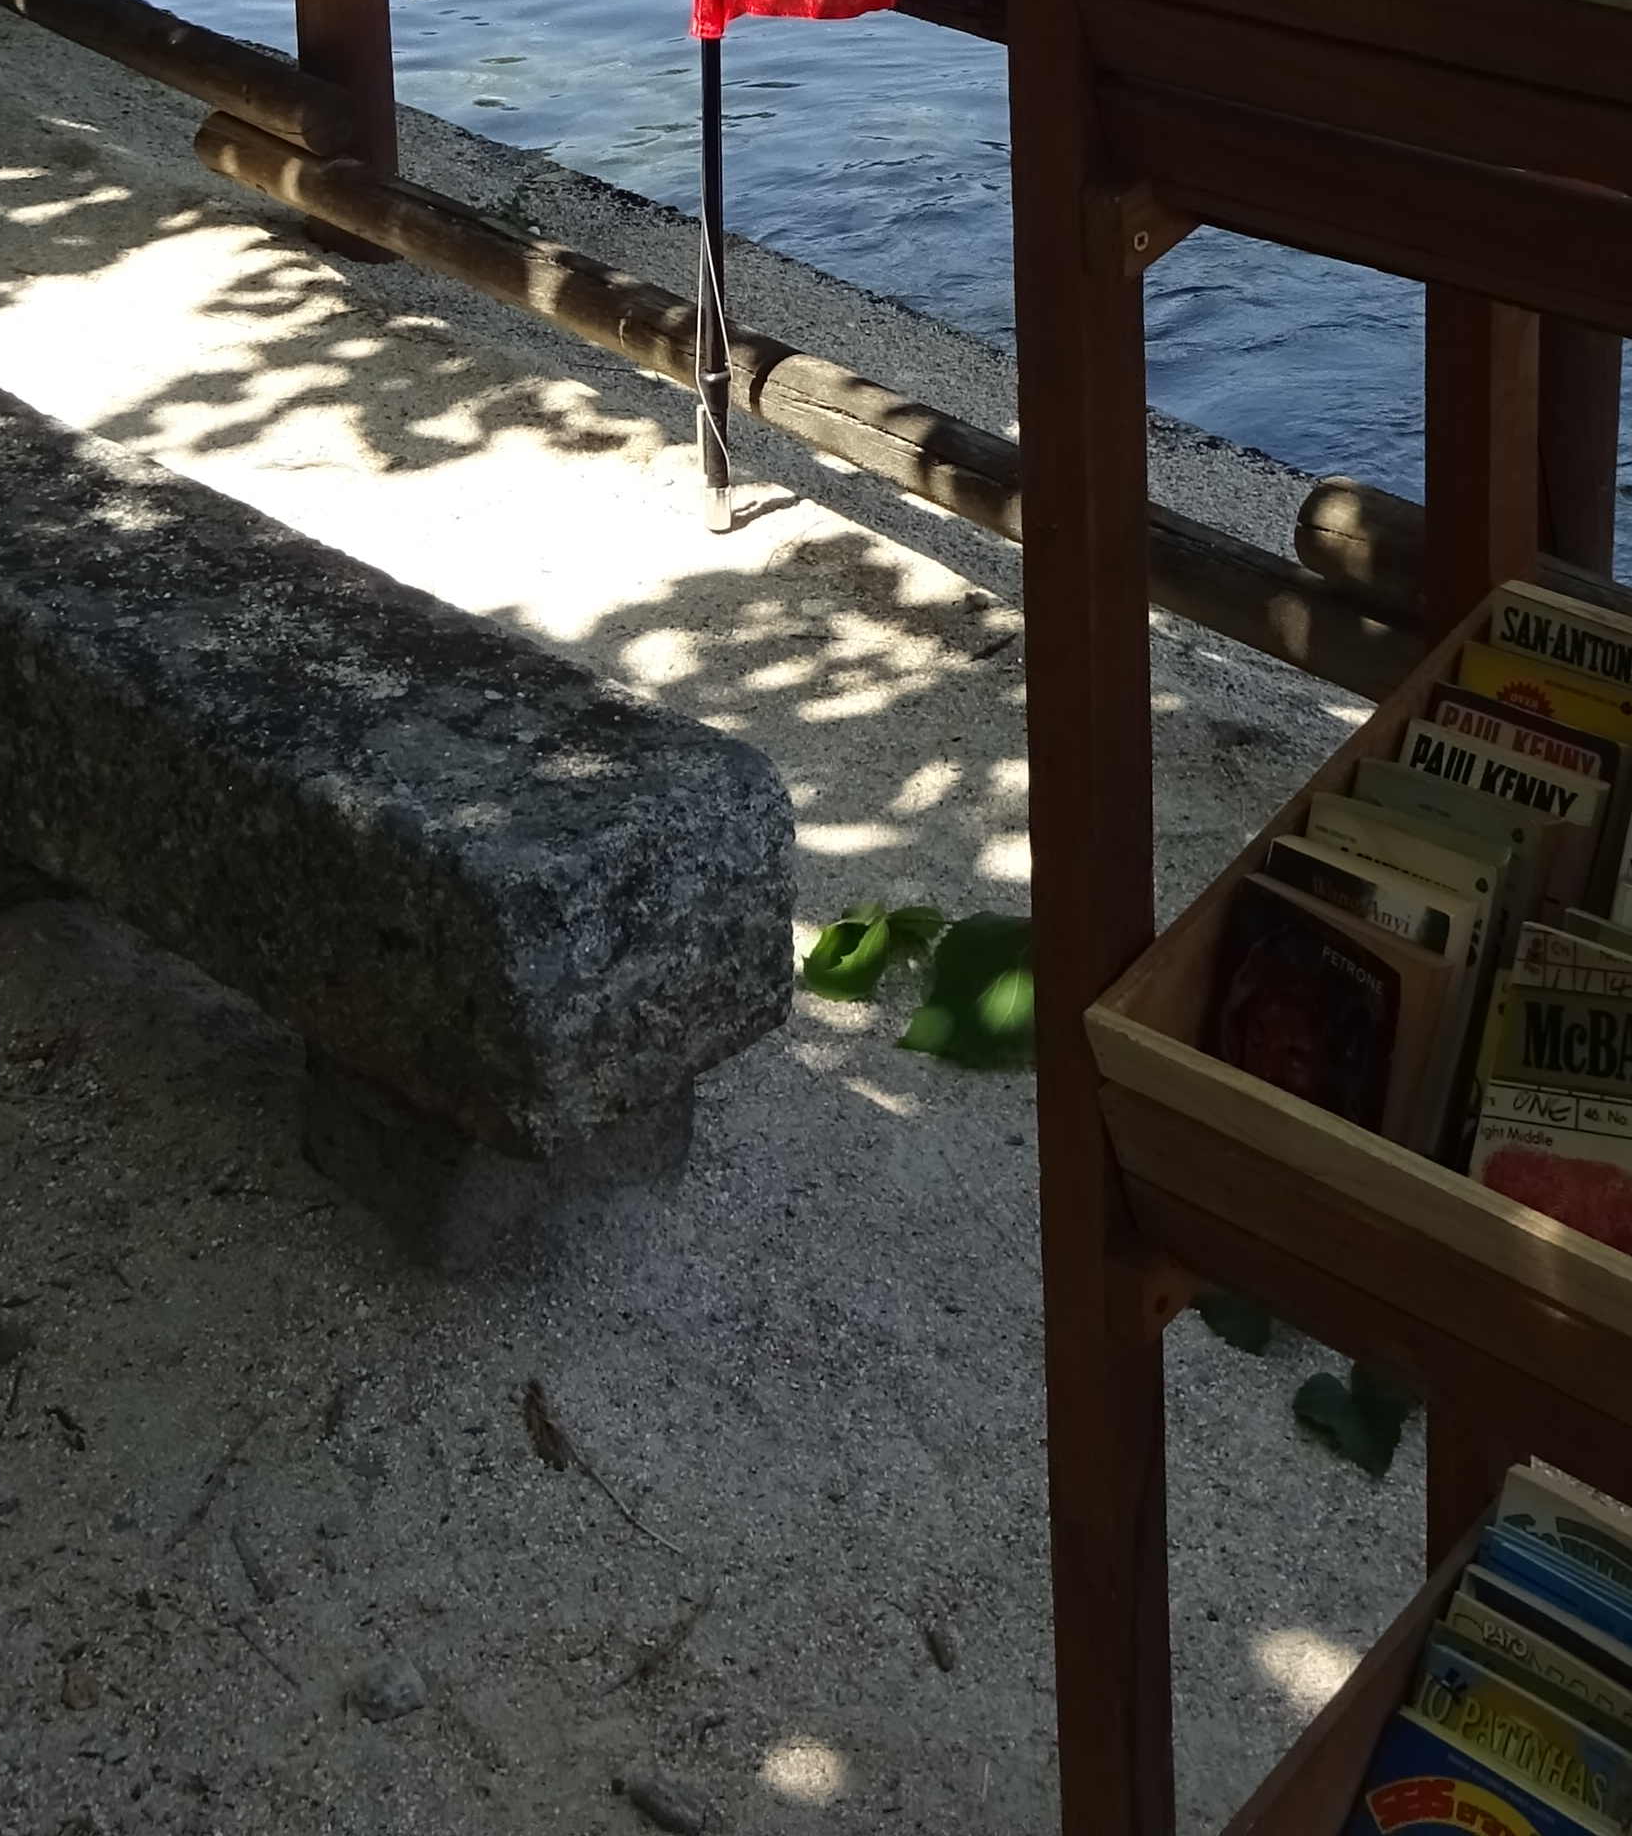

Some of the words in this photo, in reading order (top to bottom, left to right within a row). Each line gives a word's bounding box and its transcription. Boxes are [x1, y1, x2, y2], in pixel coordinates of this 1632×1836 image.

[1321, 944, 1386, 996] PETRONE
[1512, 1089, 1572, 1122] ONE
[1507, 1126, 1553, 1146] Middle
[1483, 1620, 1529, 1658] PATO
[1460, 1695, 1611, 1815] PATINHAS
